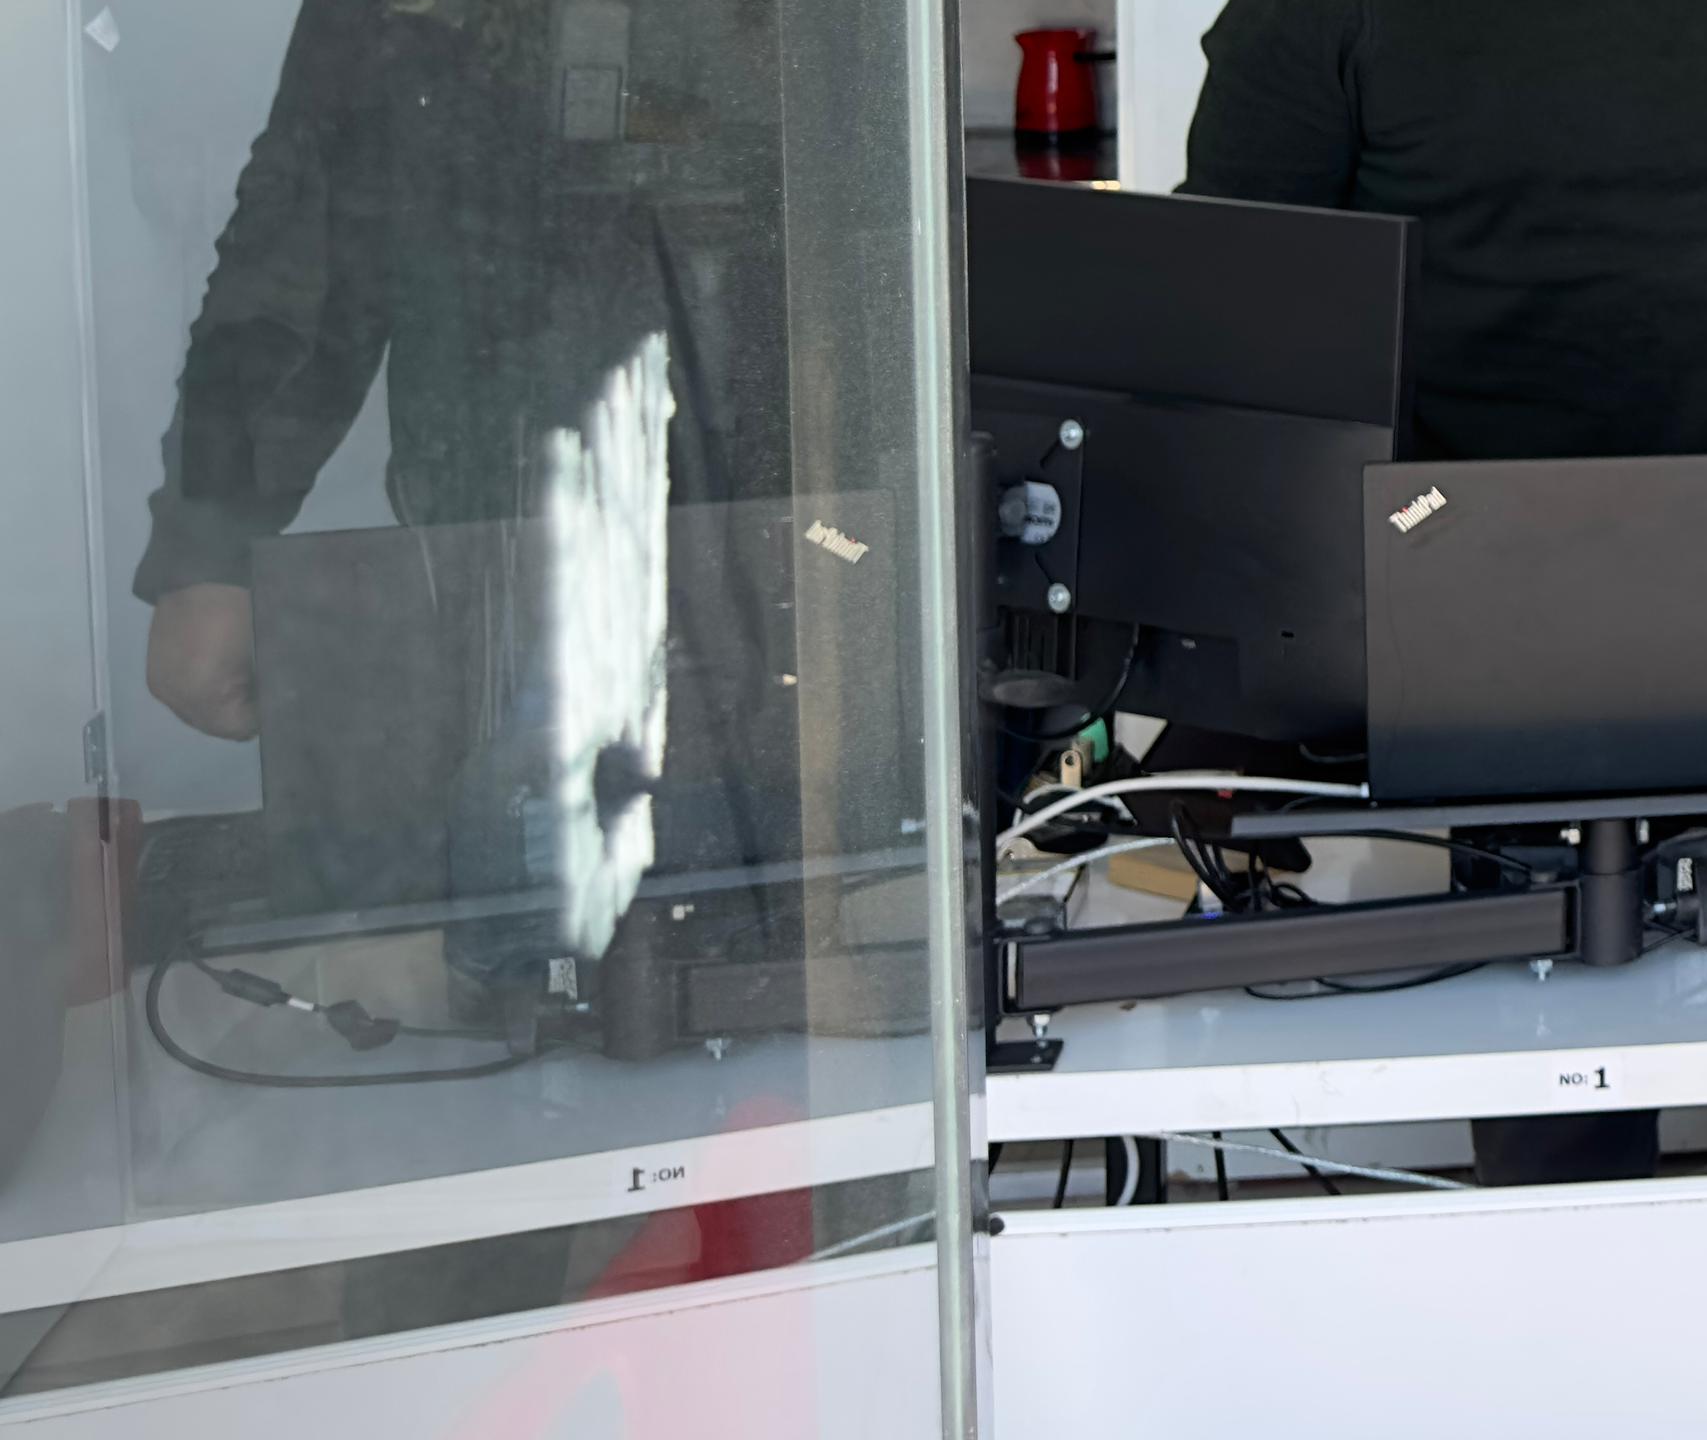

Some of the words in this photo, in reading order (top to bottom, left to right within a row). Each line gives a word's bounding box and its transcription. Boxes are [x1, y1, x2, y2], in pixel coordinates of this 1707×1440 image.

[1388, 485, 1448, 534] ThinkPad
[1559, 1072, 1588, 1086] NO:
[1594, 1065, 1610, 1089] 1
